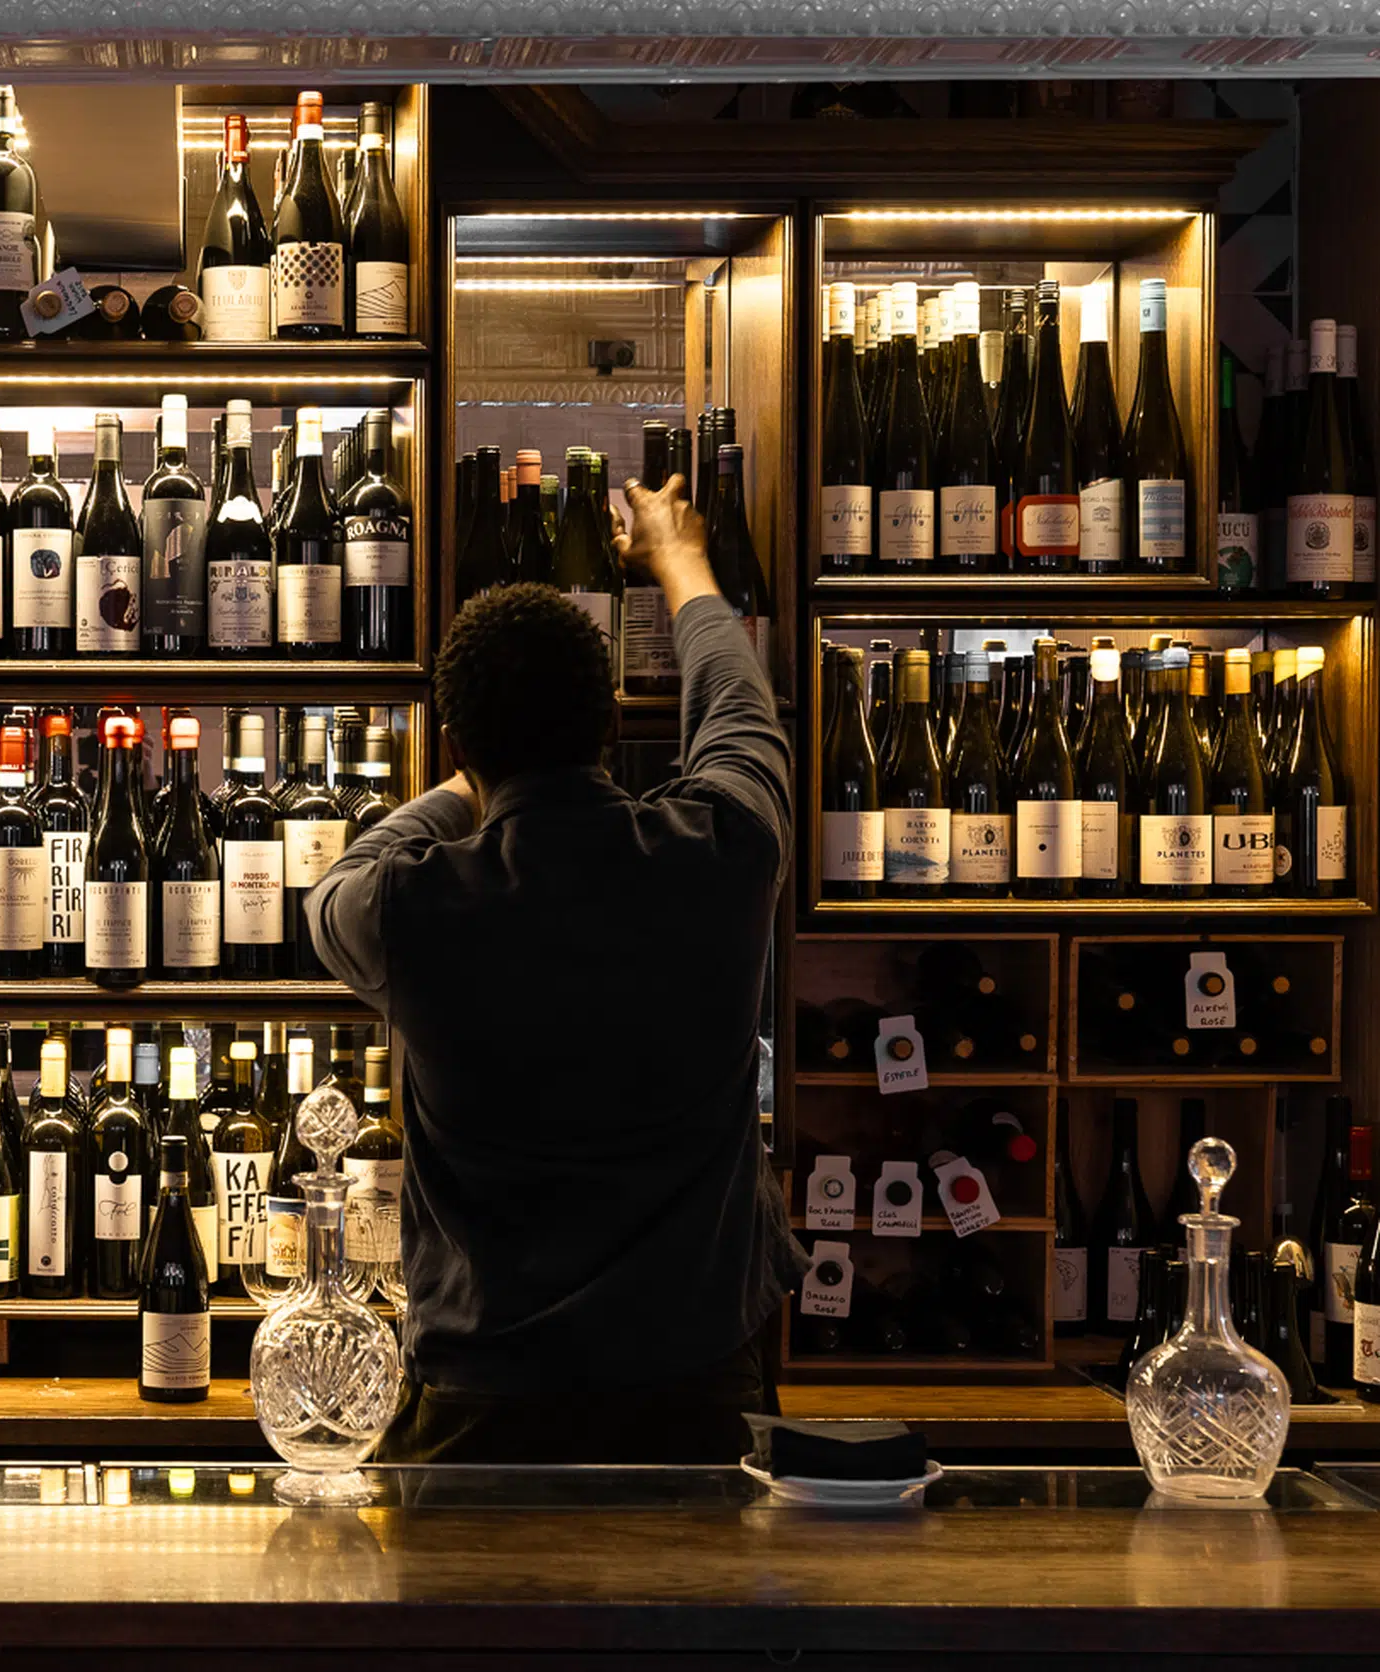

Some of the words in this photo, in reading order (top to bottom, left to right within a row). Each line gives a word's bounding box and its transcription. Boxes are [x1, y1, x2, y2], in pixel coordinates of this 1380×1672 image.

[346, 520, 407, 540] ROAGNA
[51, 838, 83, 863] FIR
[1157, 850, 1206, 859] PLANETES
[51, 865, 70, 887] RI
[239, 881, 281, 889] MONTALCINO
[243, 872, 270, 881] ROSSO
[51, 887, 83, 912] FIR
[52, 914, 70, 938] RI
[226, 1159, 259, 1191] KA
